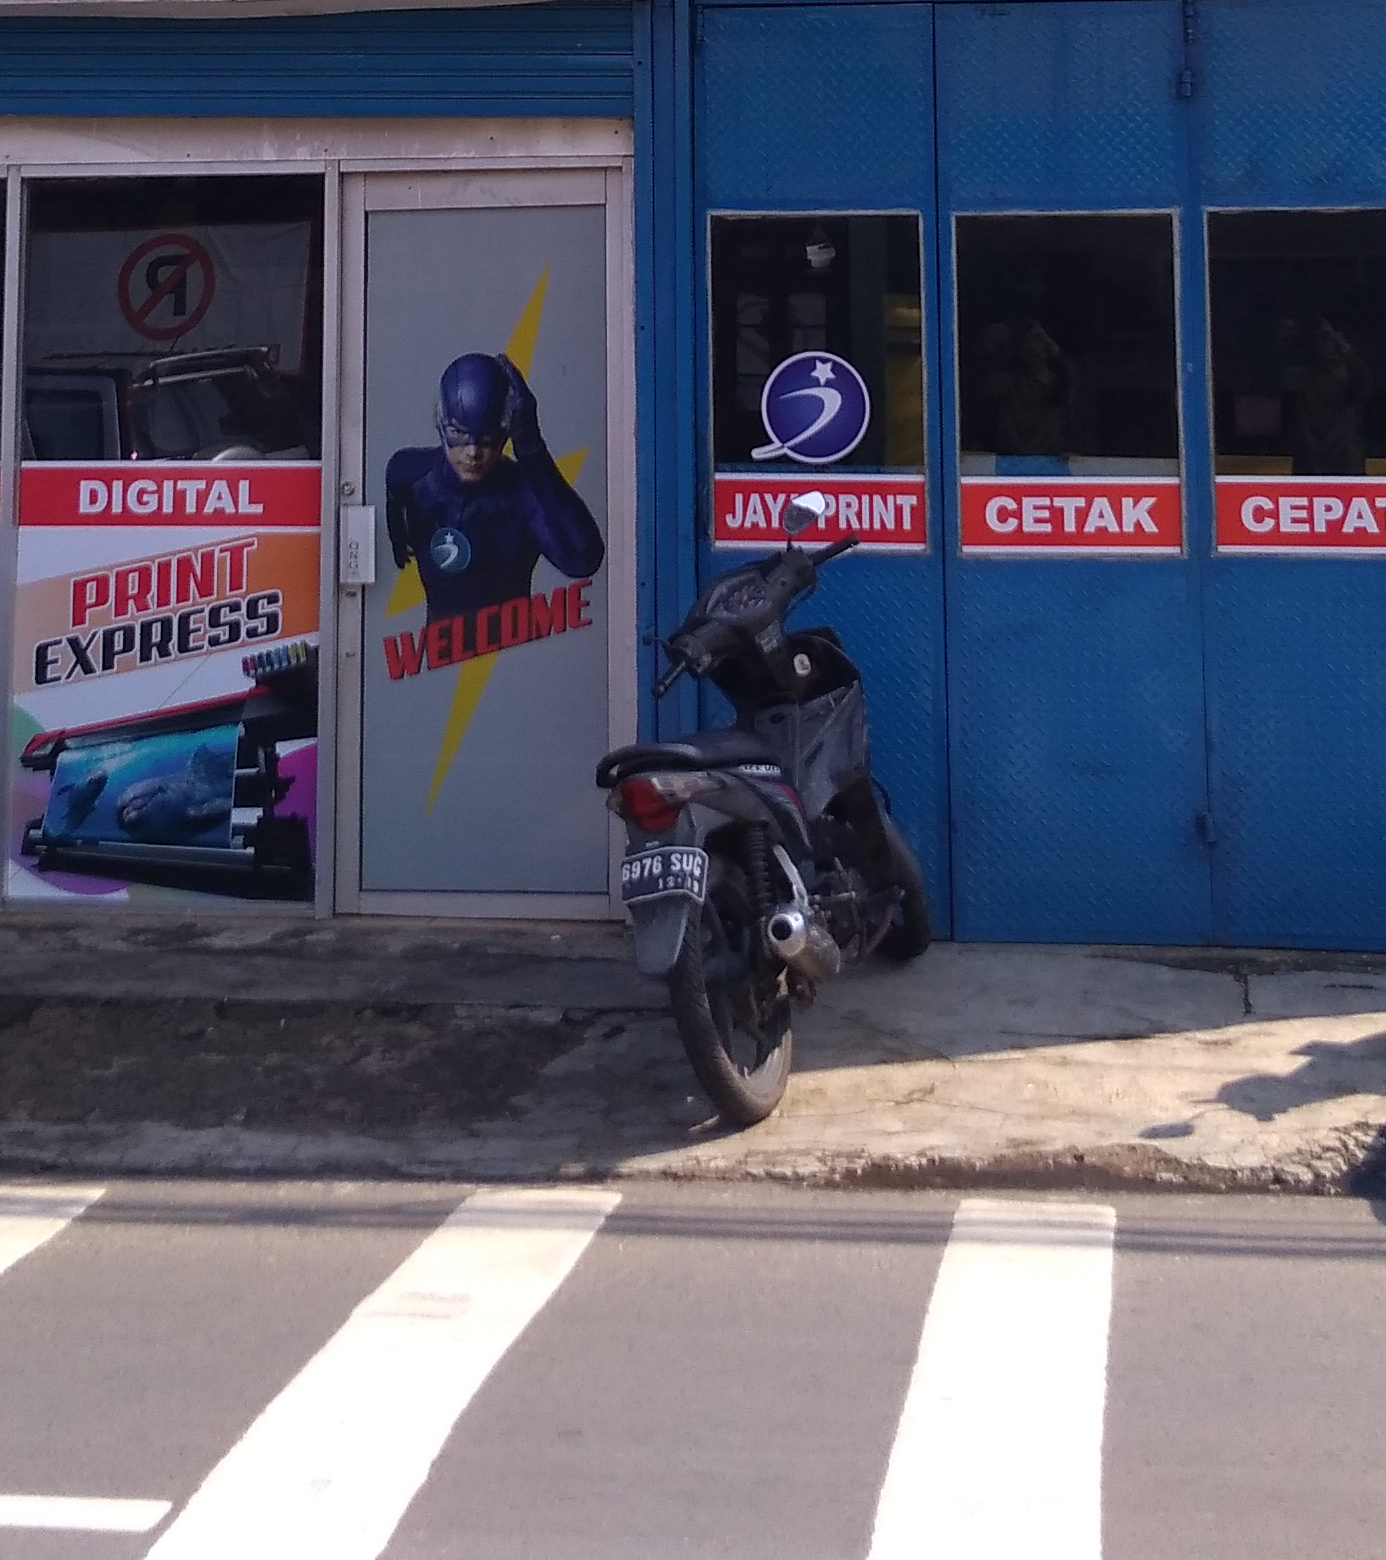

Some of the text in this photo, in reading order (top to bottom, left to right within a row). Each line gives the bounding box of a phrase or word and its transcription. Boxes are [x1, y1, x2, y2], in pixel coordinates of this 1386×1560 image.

[79, 479, 263, 514] DIGITAL
[985, 496, 1159, 533] CETAK
[70, 538, 257, 628] PRINT
[34, 589, 283, 686] EXPRESS
[383, 578, 592, 680] WELCOME
